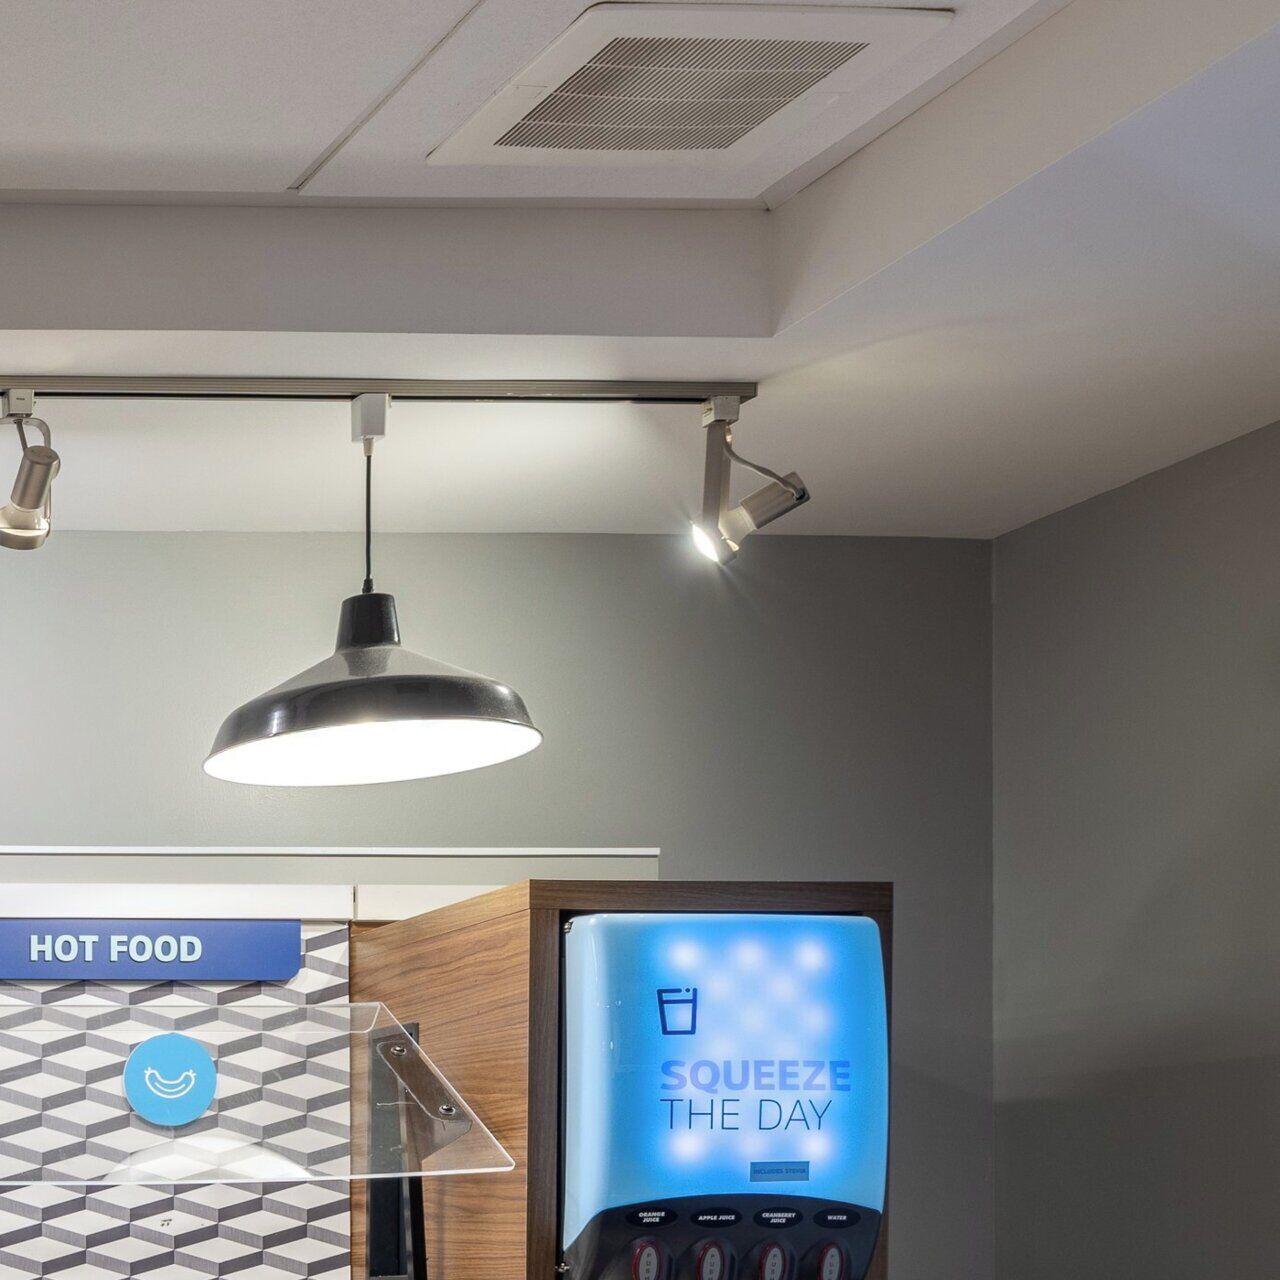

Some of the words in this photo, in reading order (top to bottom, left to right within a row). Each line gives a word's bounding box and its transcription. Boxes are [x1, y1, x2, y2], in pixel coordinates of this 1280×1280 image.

[30, 935, 99, 962] HOT
[110, 935, 203, 963] FOOD
[660, 1059, 852, 1094] SQUEEZE
[660, 1098, 741, 1131] THE
[758, 1098, 833, 1131] DAY
